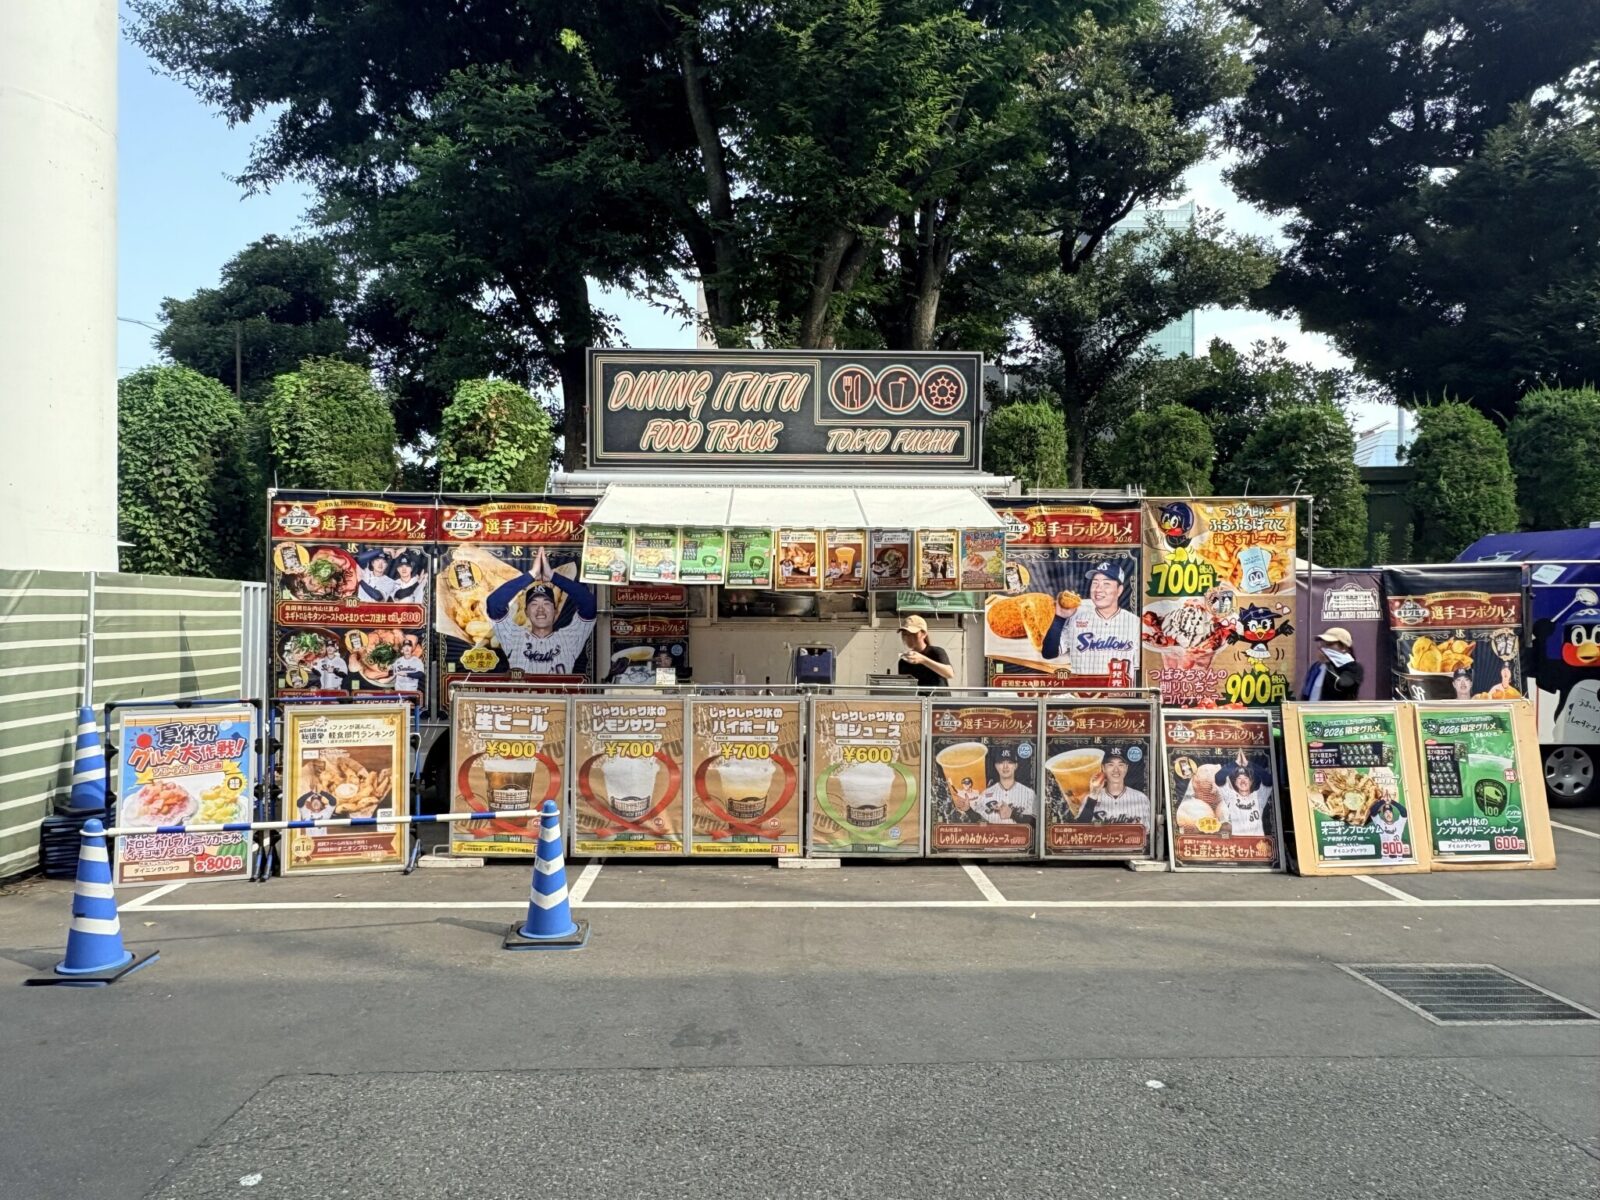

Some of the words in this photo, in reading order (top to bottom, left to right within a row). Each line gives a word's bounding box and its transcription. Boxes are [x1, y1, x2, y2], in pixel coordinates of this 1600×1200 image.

[608, 371, 712, 418] DINING
[713, 371, 810, 413] ITUTU
[640, 418, 704, 453] FOOD
[706, 418, 783, 453] TRACK
[826, 429, 891, 453] TOKYO
[891, 429, 960, 453] FUCHU
[321, 515, 426, 533] 選手コラボグルメ
[1032, 521, 1133, 537] 選手コラボグルメ
[1213, 533, 1286, 545] 選べるフレーバー
[1152, 564, 1213, 595] 700円
[1431, 605, 1516, 619] 選手コラボグルメ
[1076, 632, 1134, 652] Swallows
[1150, 669, 1227, 680] つばみちゃんの
[1160, 681, 1217, 693] 削りいちご
[1226, 673, 1286, 704] 900円
[475, 704, 550, 714] アサヒスーパードライ
[832, 710, 905, 722] しゃりしゃり氷の
[475, 713, 549, 732] 生ビール
[592, 719, 667, 732] レモンサワー
[712, 720, 779, 734] ハイボール
[963, 719, 1033, 730] 選手コラボグルメ
[1076, 718, 1145, 729] 選手コラボグルメ
[156, 722, 218, 746] 夏休み
[328, 730, 395, 739] 軽食部門ランキング
[1196, 729, 1265, 741] 選手コラボグルメ
[128, 738, 245, 772] グルメ大作戦!
[486, 741, 537, 757] ¥900
[605, 741, 654, 757] ¥700
[721, 743, 770, 759] ¥700
[843, 746, 892, 763] ¥600
[1485, 806, 1499, 816] 100
[1436, 818, 1488, 827] しゃりしゃり氷の
[1321, 826, 1384, 835] オニオンブロッサム
[1436, 826, 1519, 835] ノンアルグリーンスパーク
[125, 833, 242, 850] トロピカルフルーツかき氷
[940, 833, 1010, 844] しゃりしゃりみかんジュース
[1184, 845, 1255, 858] お土産たまねぎセット
[194, 857, 242, 872] 各800円
